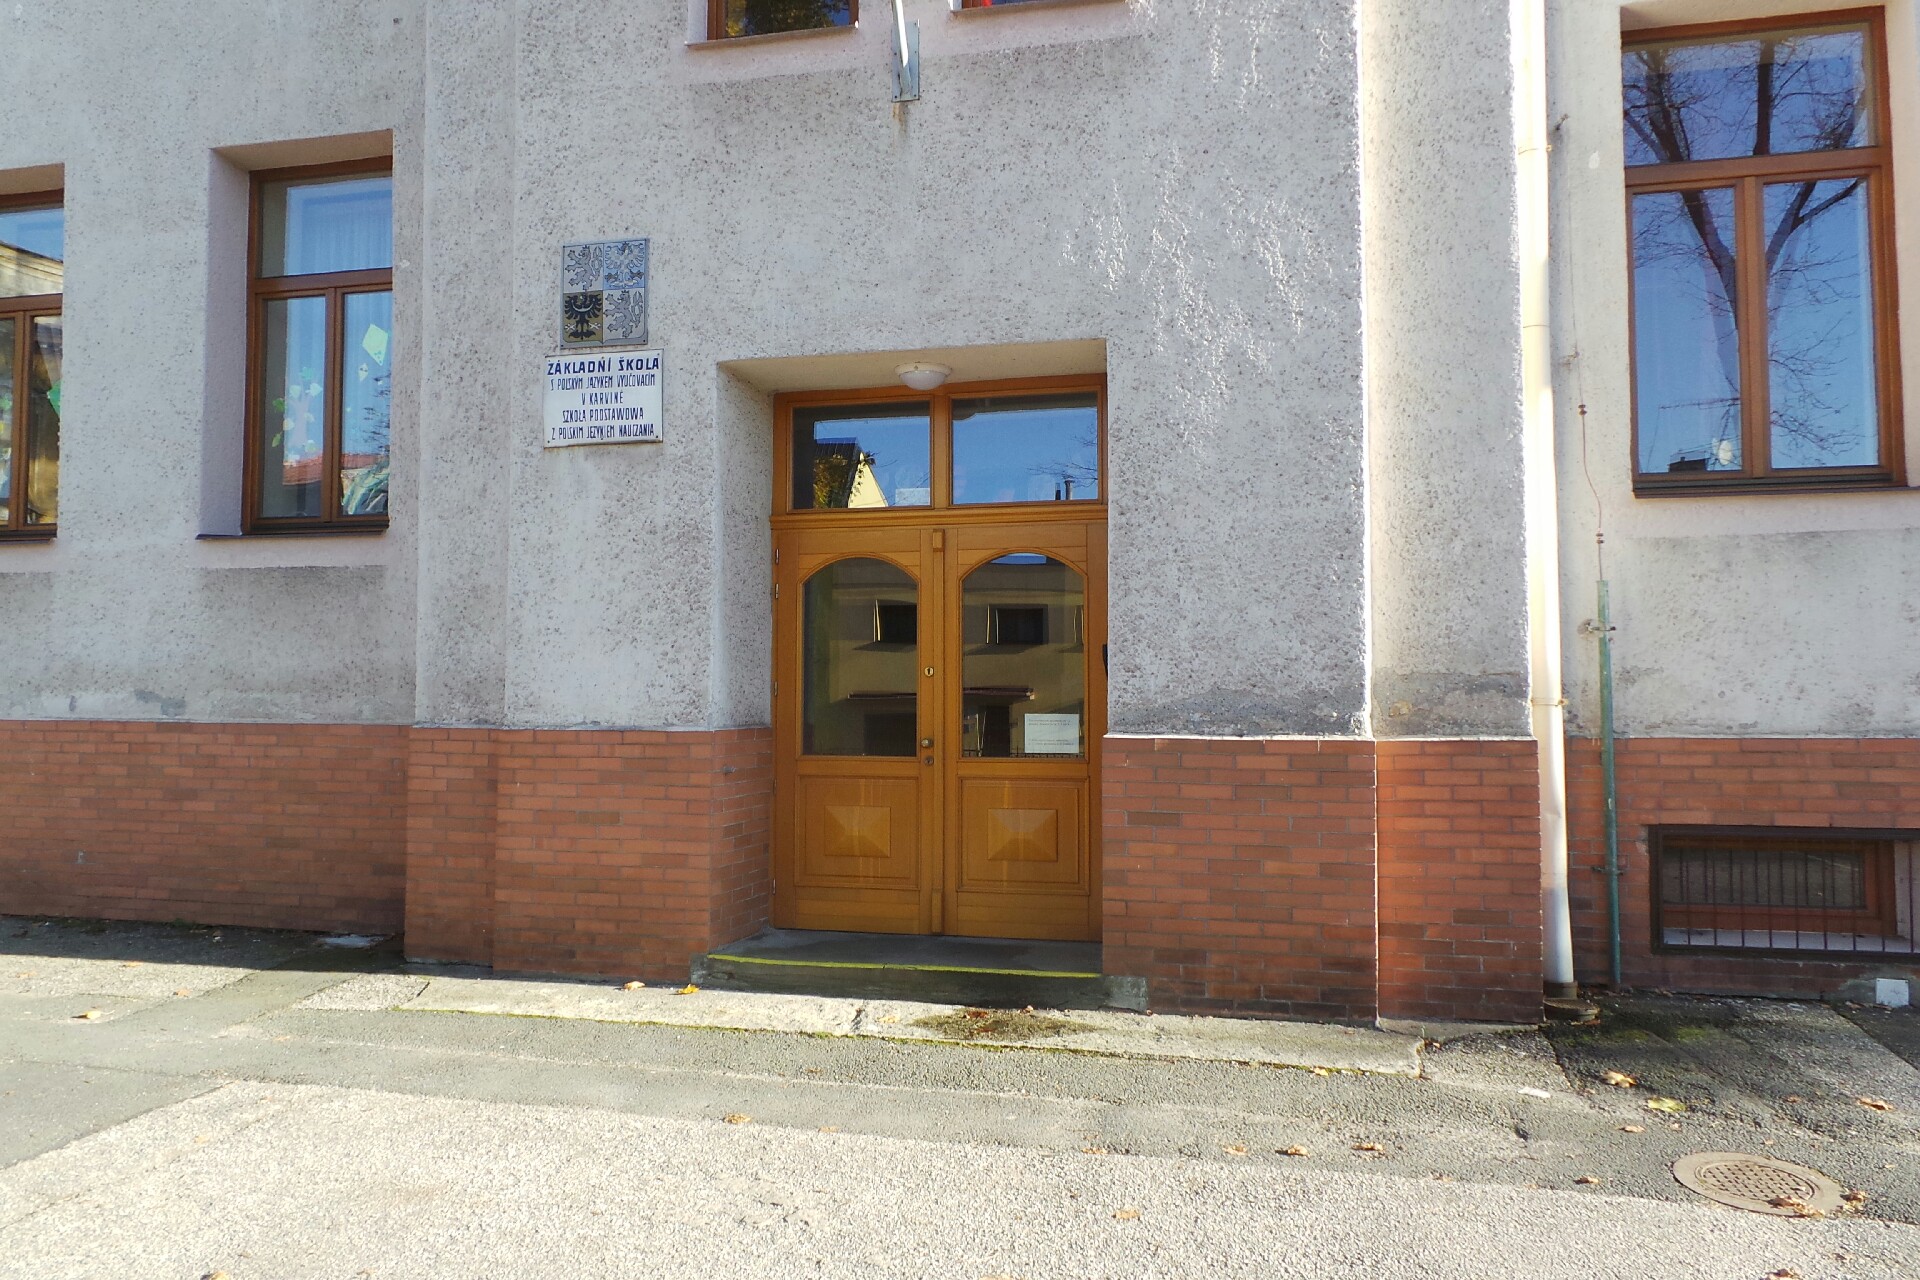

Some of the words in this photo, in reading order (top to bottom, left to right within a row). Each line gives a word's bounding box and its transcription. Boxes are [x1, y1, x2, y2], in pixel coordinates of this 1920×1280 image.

[547, 357, 611, 376] ZÁKLADNÍ
[618, 356, 659, 372] ŠKOLA
[550, 379, 554, 391] S
[586, 376, 613, 389] JAZYKEM
[581, 393, 586, 406] V
[562, 410, 587, 423] SZKOŁA
[590, 407, 644, 422] PODSTAWOWA
[551, 427, 556, 441] Z
[559, 426, 584, 440] POLSKIM
[618, 423, 655, 438] NAUCZANIA
